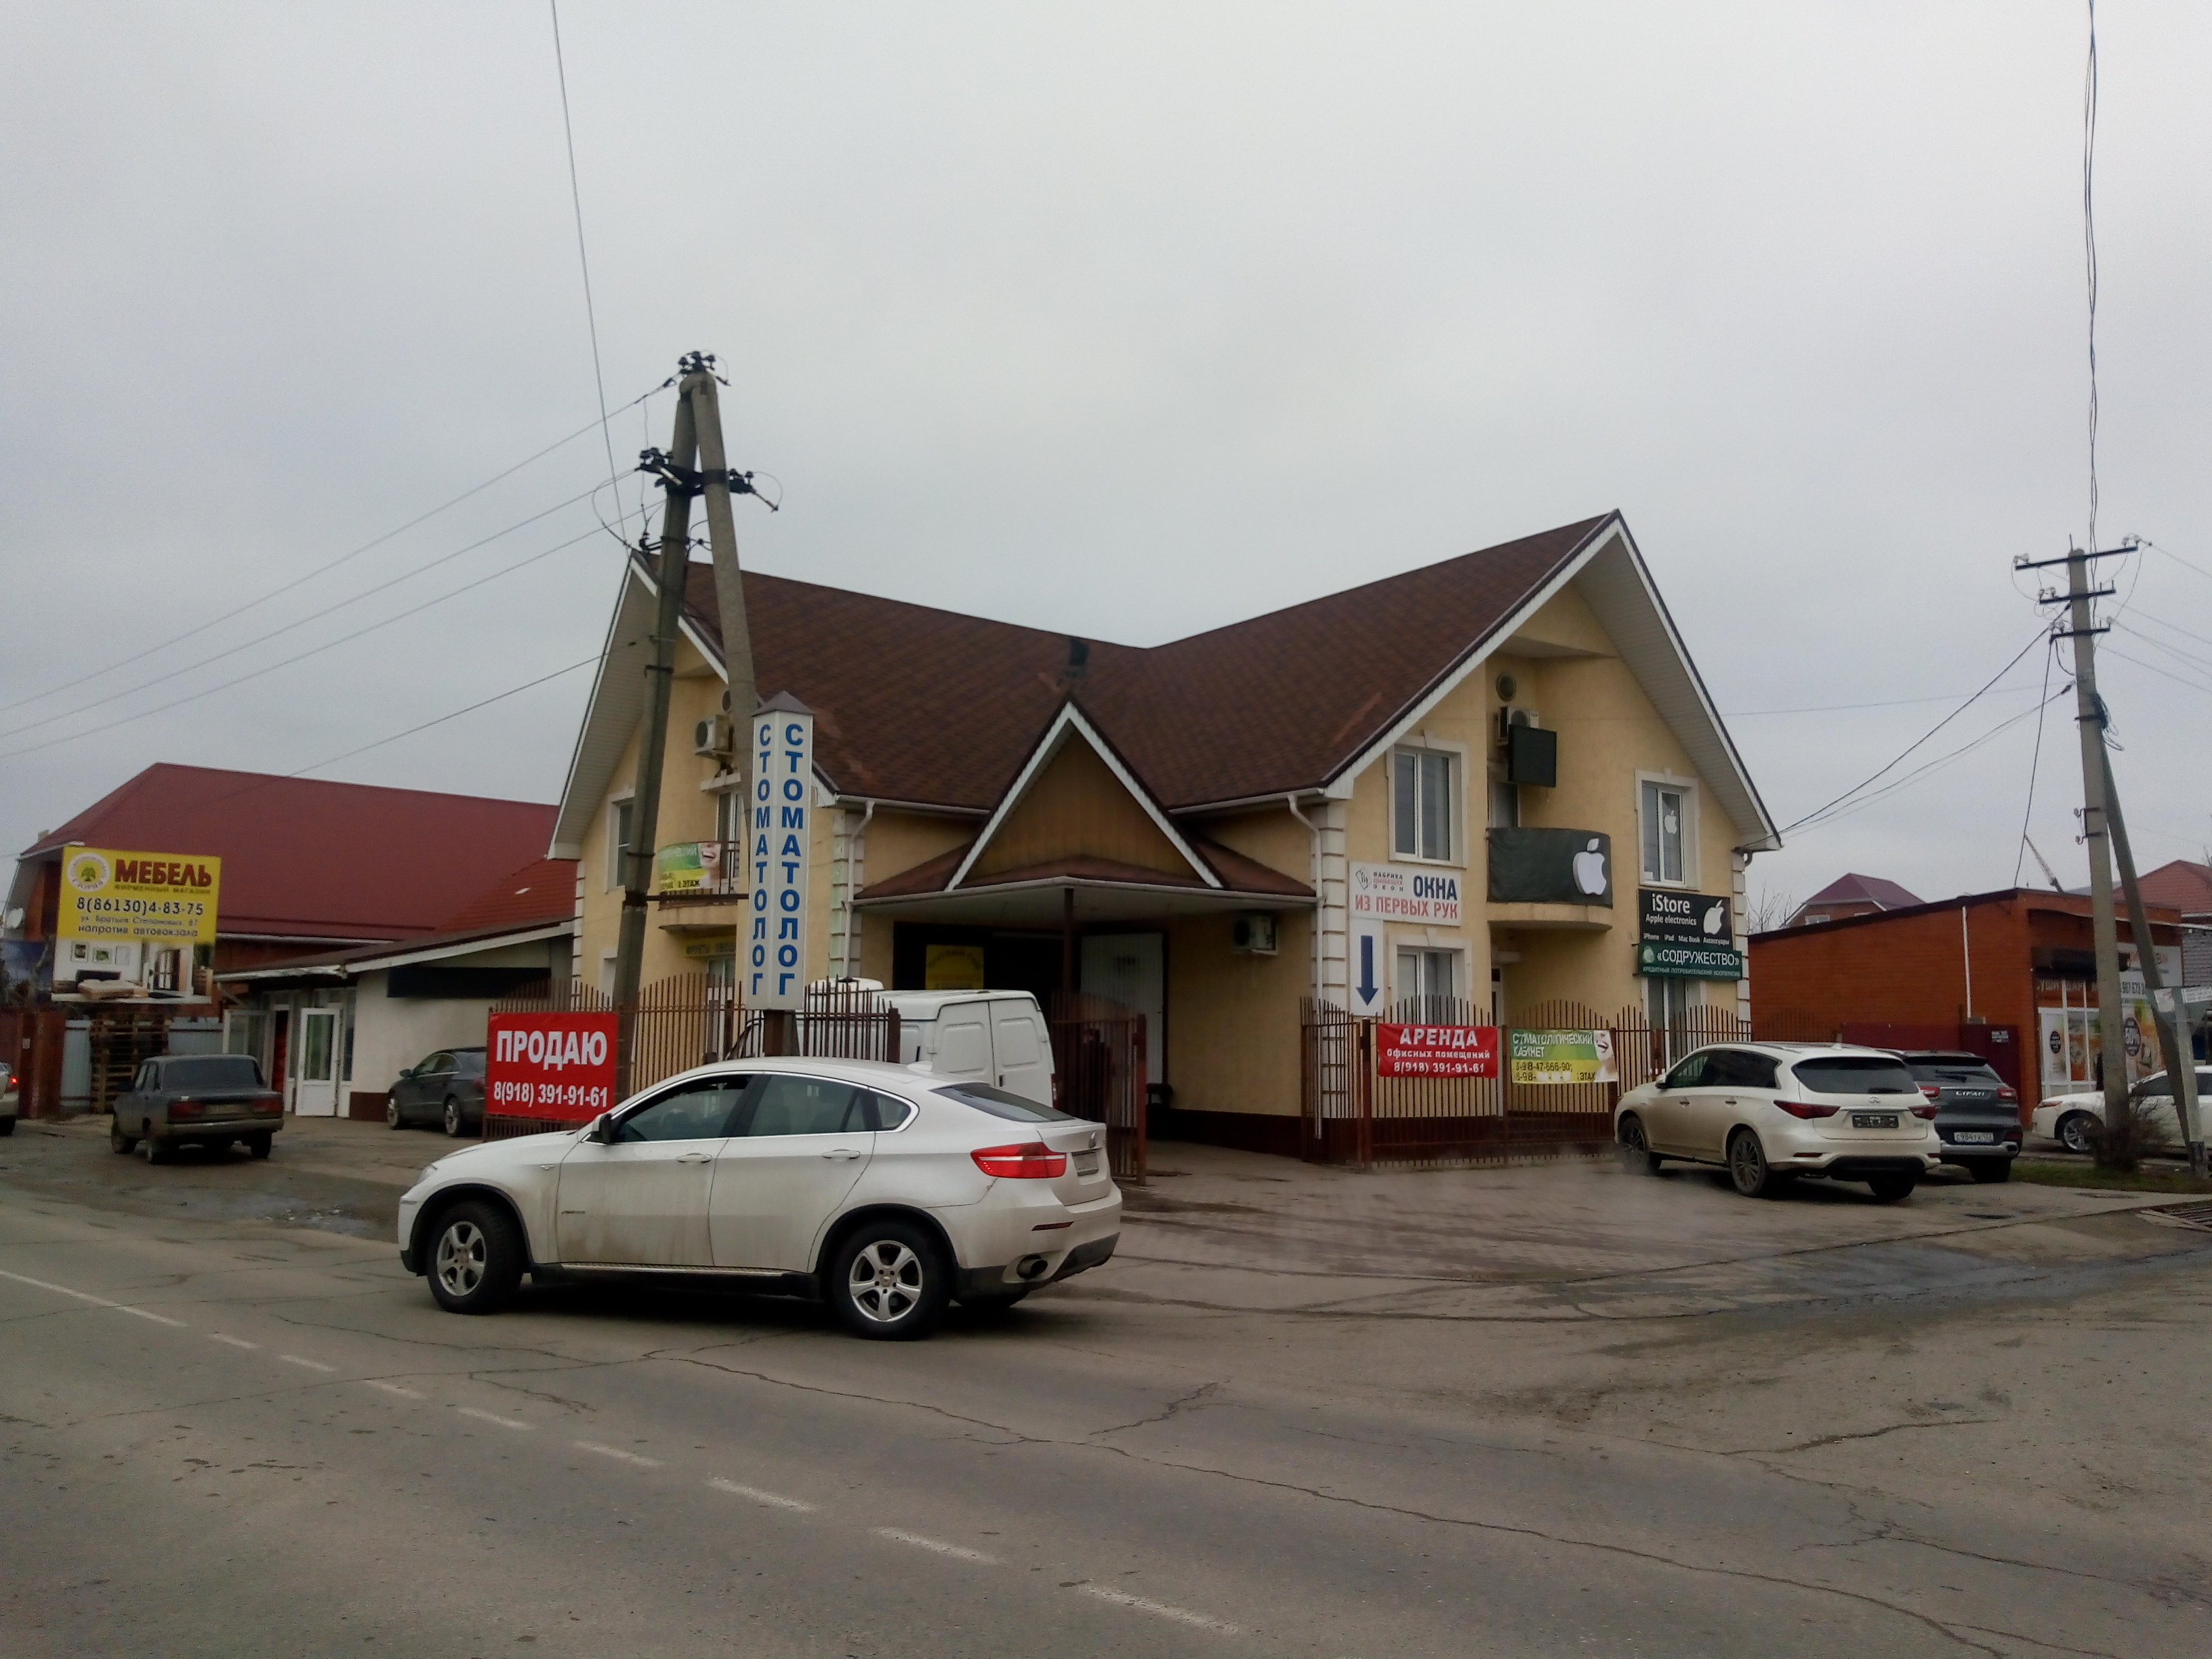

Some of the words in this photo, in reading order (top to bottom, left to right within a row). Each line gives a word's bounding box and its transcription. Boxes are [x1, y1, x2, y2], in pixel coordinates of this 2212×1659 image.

[752, 722, 772, 996] СТОМАТОЛОГ
[777, 722, 804, 996] СТОМАТОЛОГ
[115, 859, 212, 887] МЕБЕЛЬ
[1373, 872, 1403, 880] ФАБРИКА
[1413, 875, 1458, 901] ОКНА
[77, 897, 204, 916] 8(86130)4-83-75
[1355, 894, 1371, 912] ИЗ
[1376, 896, 1429, 917] ПЕРВЫХ
[1433, 901, 1458, 919] РУК
[1652, 893, 1690, 914] iStore
[1645, 914, 1664, 924] Apple
[1664, 914, 1696, 926] electronics
[1657, 949, 1740, 966] «СОДРУЖЕСТВО»
[1399, 1027, 1478, 1049] АРЕНДА
[496, 1030, 607, 1071] ПРОДАЮ
[1387, 1048, 1432, 1059] Офисных
[1435, 1050, 1490, 1060] помещений
[1393, 1061, 1429, 1074] 8(918)
[1433, 1062, 1484, 1073] 391-91-61
[494, 1080, 535, 1107] 8(918)
[537, 1084, 608, 1107] 391-91-61
